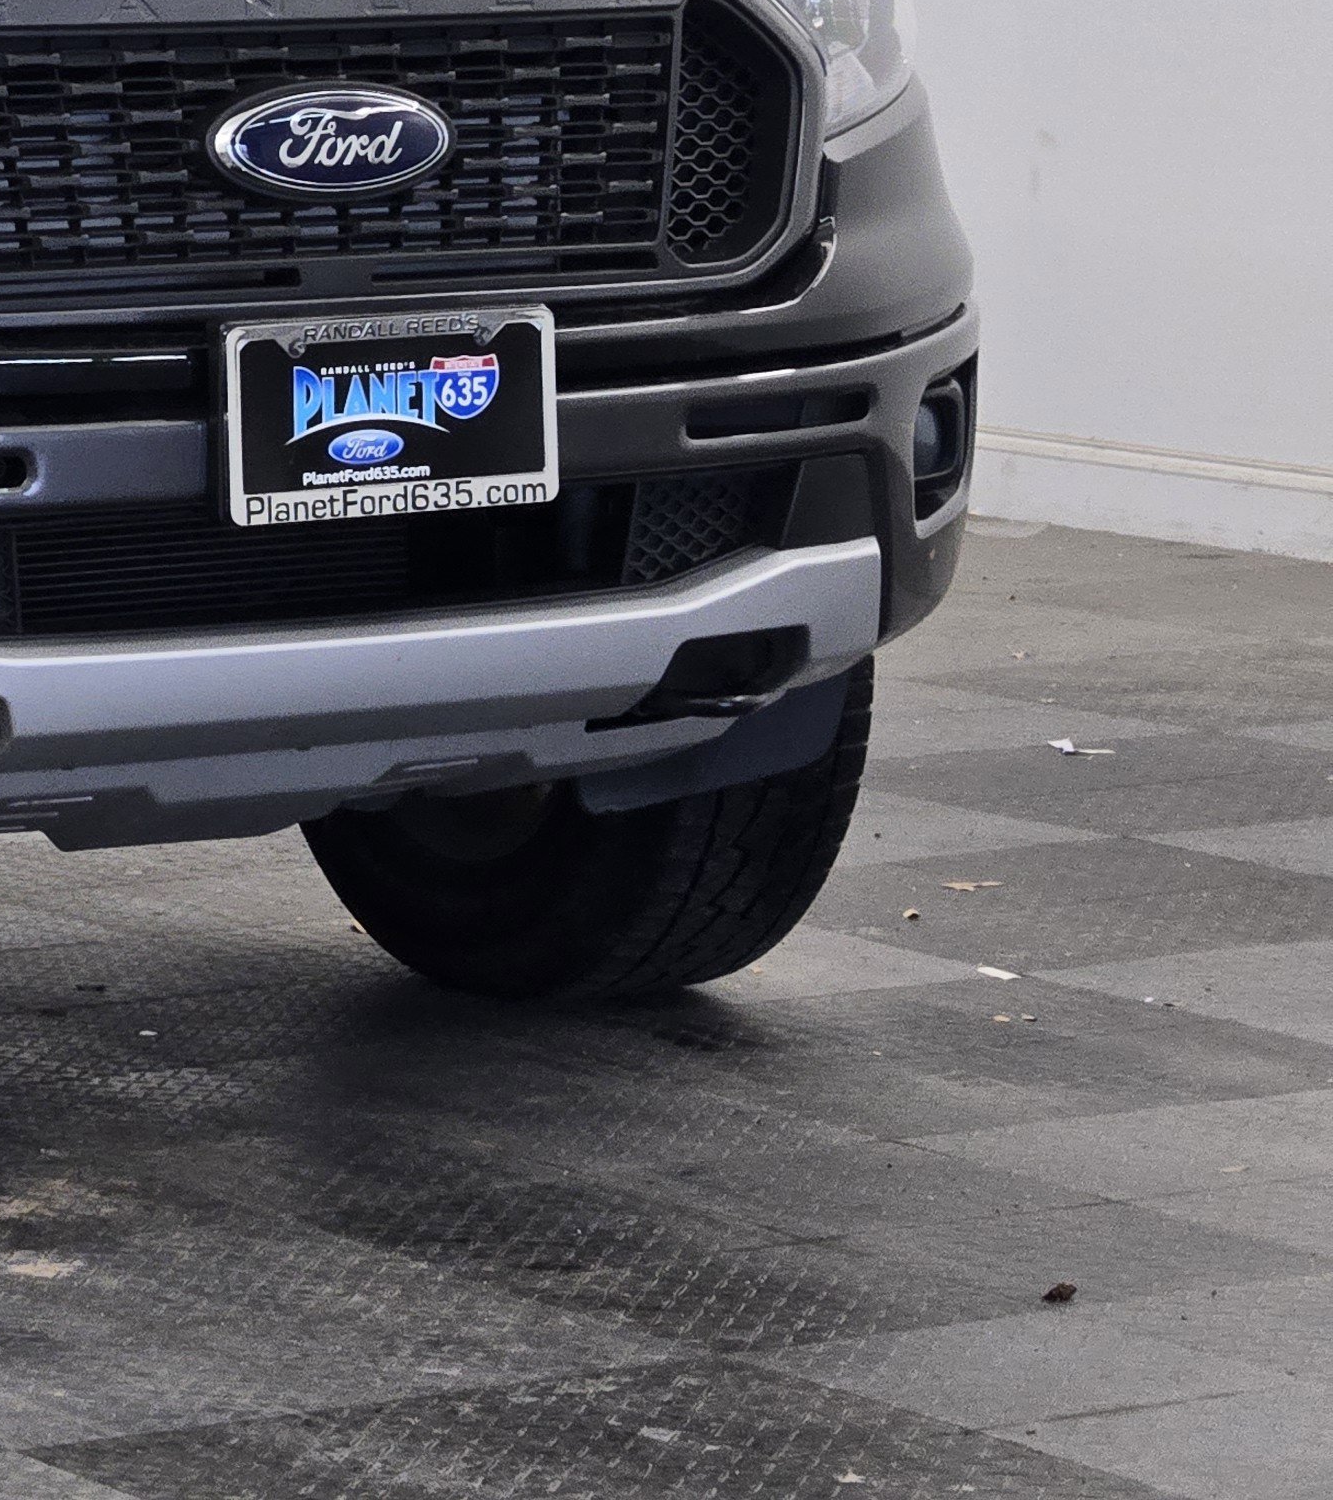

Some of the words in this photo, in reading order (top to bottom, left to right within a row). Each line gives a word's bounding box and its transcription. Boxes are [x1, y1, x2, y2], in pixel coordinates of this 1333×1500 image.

[278, 107, 403, 168] Ford
[303, 321, 400, 343] RANDALL
[406, 314, 479, 334] REED'S
[293, 366, 439, 438] PLANET
[441, 375, 488, 408] 635
[341, 437, 388, 459] Ford
[302, 464, 430, 486] PlanetFord635.com
[245, 480, 547, 525] PlanetFord635.com
